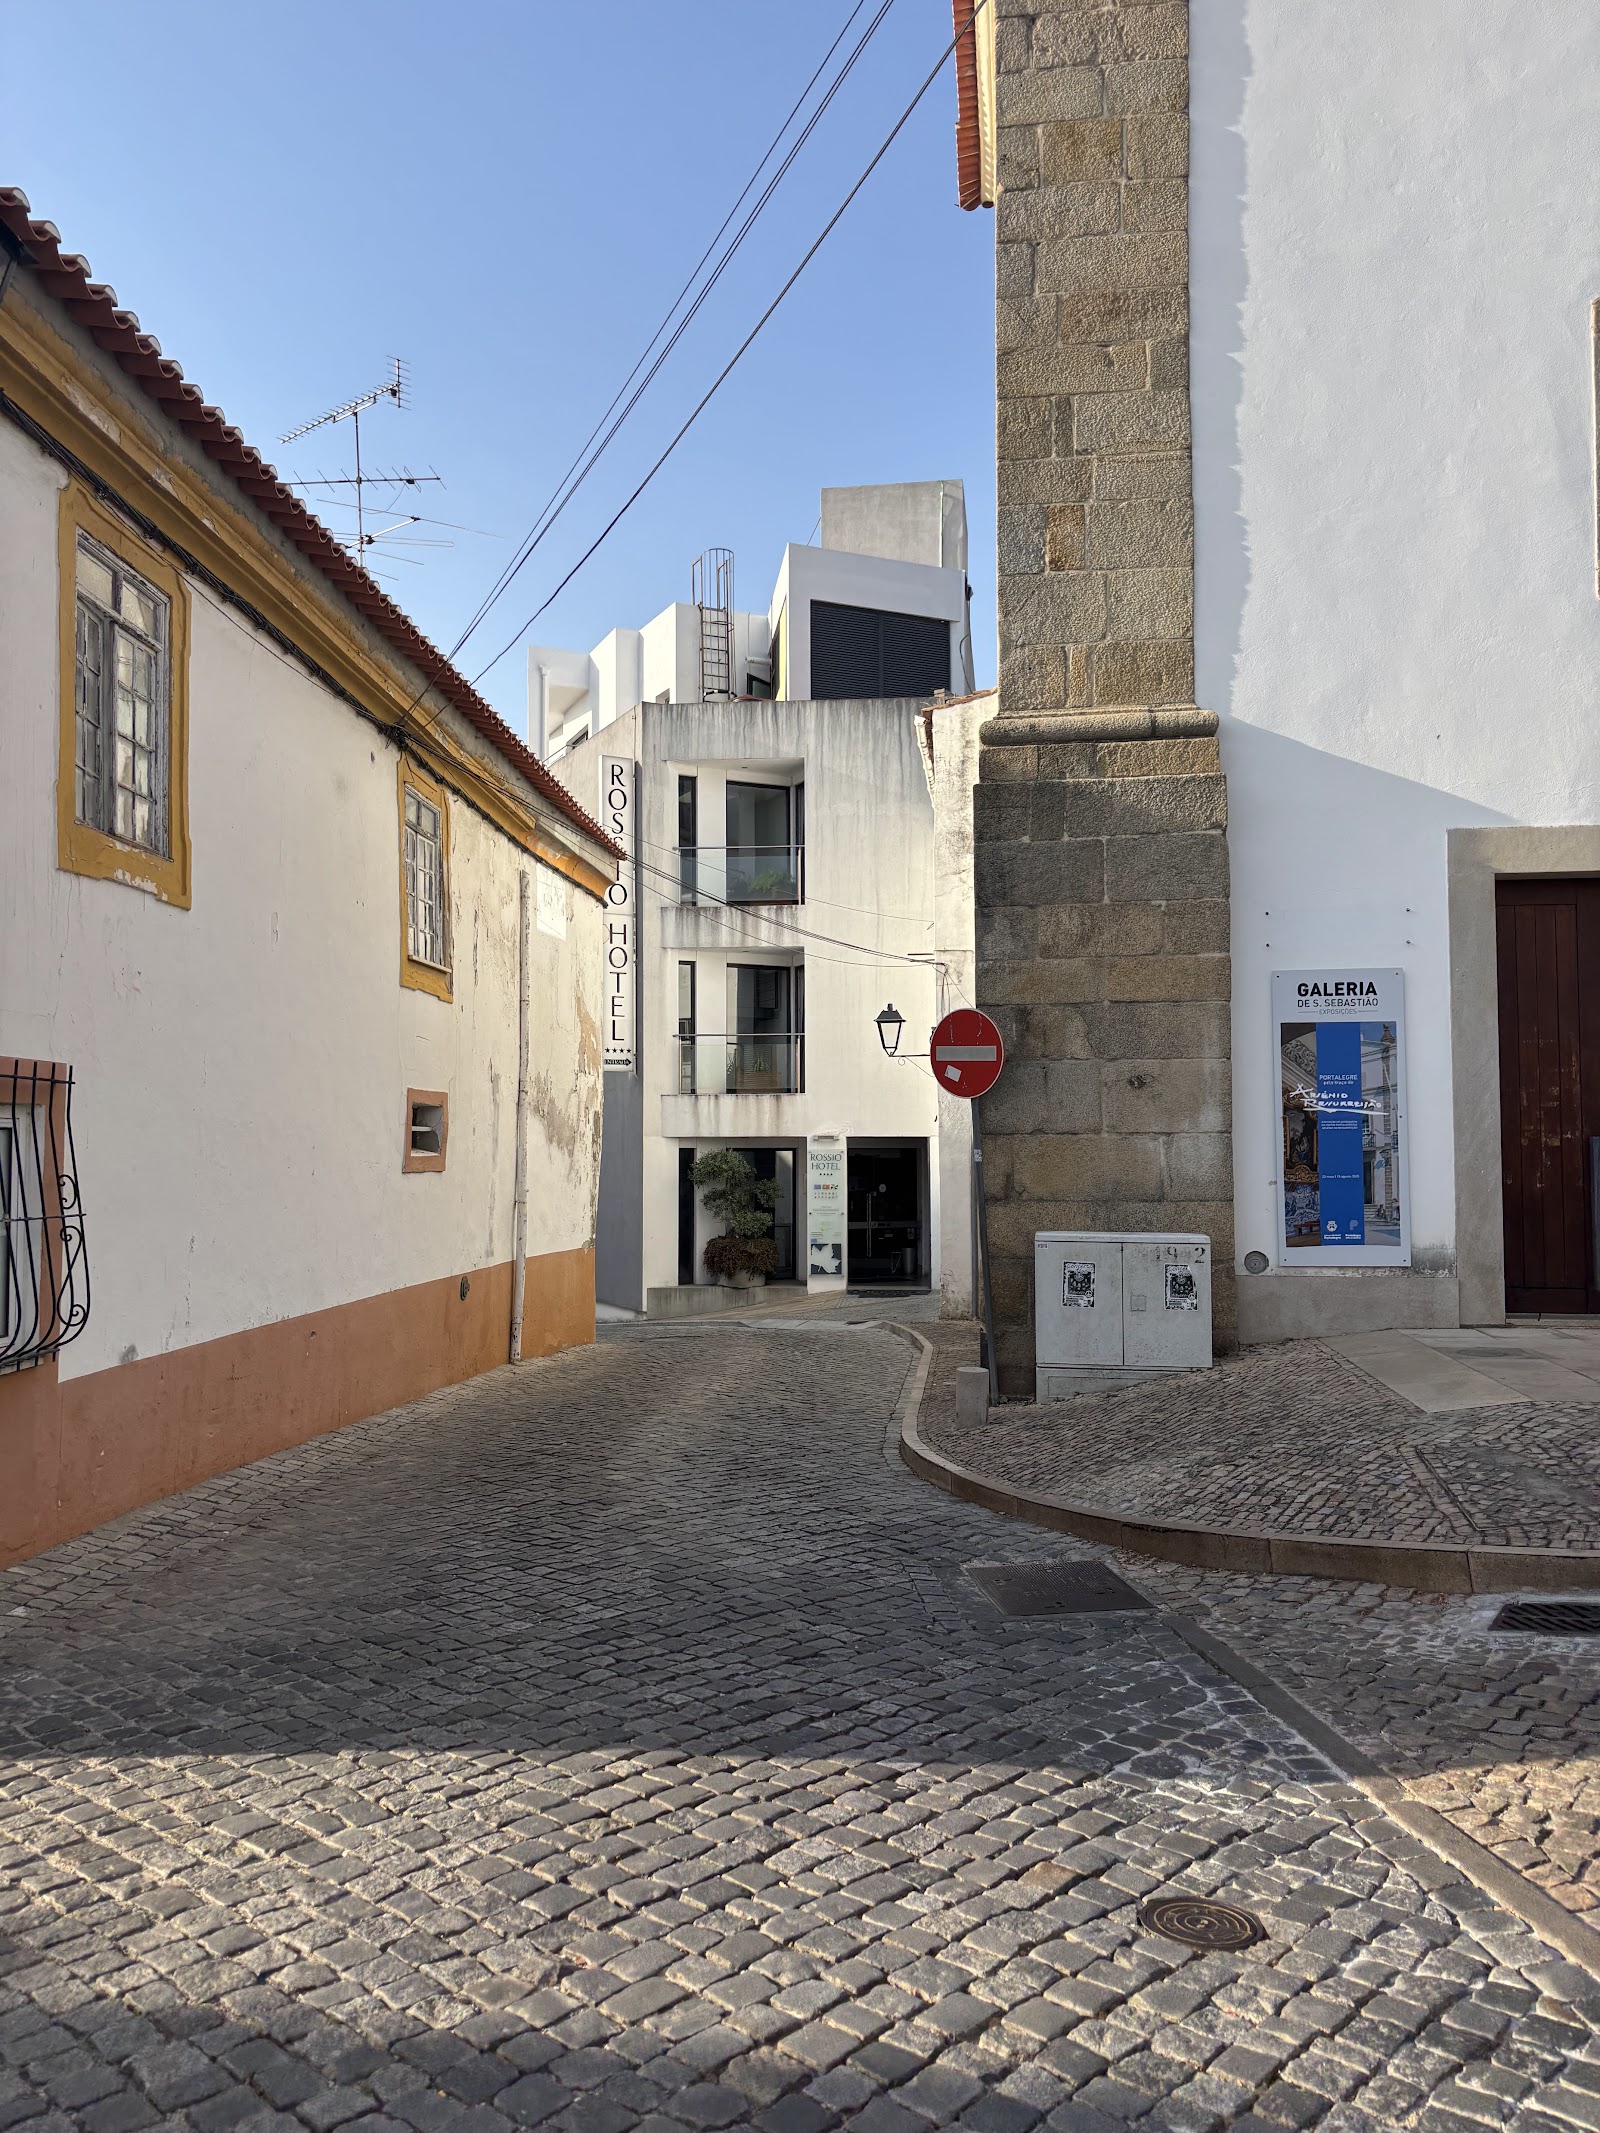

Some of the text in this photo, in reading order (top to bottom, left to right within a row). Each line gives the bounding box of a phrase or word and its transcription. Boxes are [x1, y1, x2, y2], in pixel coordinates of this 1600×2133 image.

[608, 764, 628, 1042] ROSIO HOTEL
[1297, 981, 1378, 997] GALERIA
[1297, 996, 1379, 1008] DE S. SEBASTIÃO
[810, 1153, 842, 1162] ROSSIO
[811, 1162, 840, 1171] HOTEL
